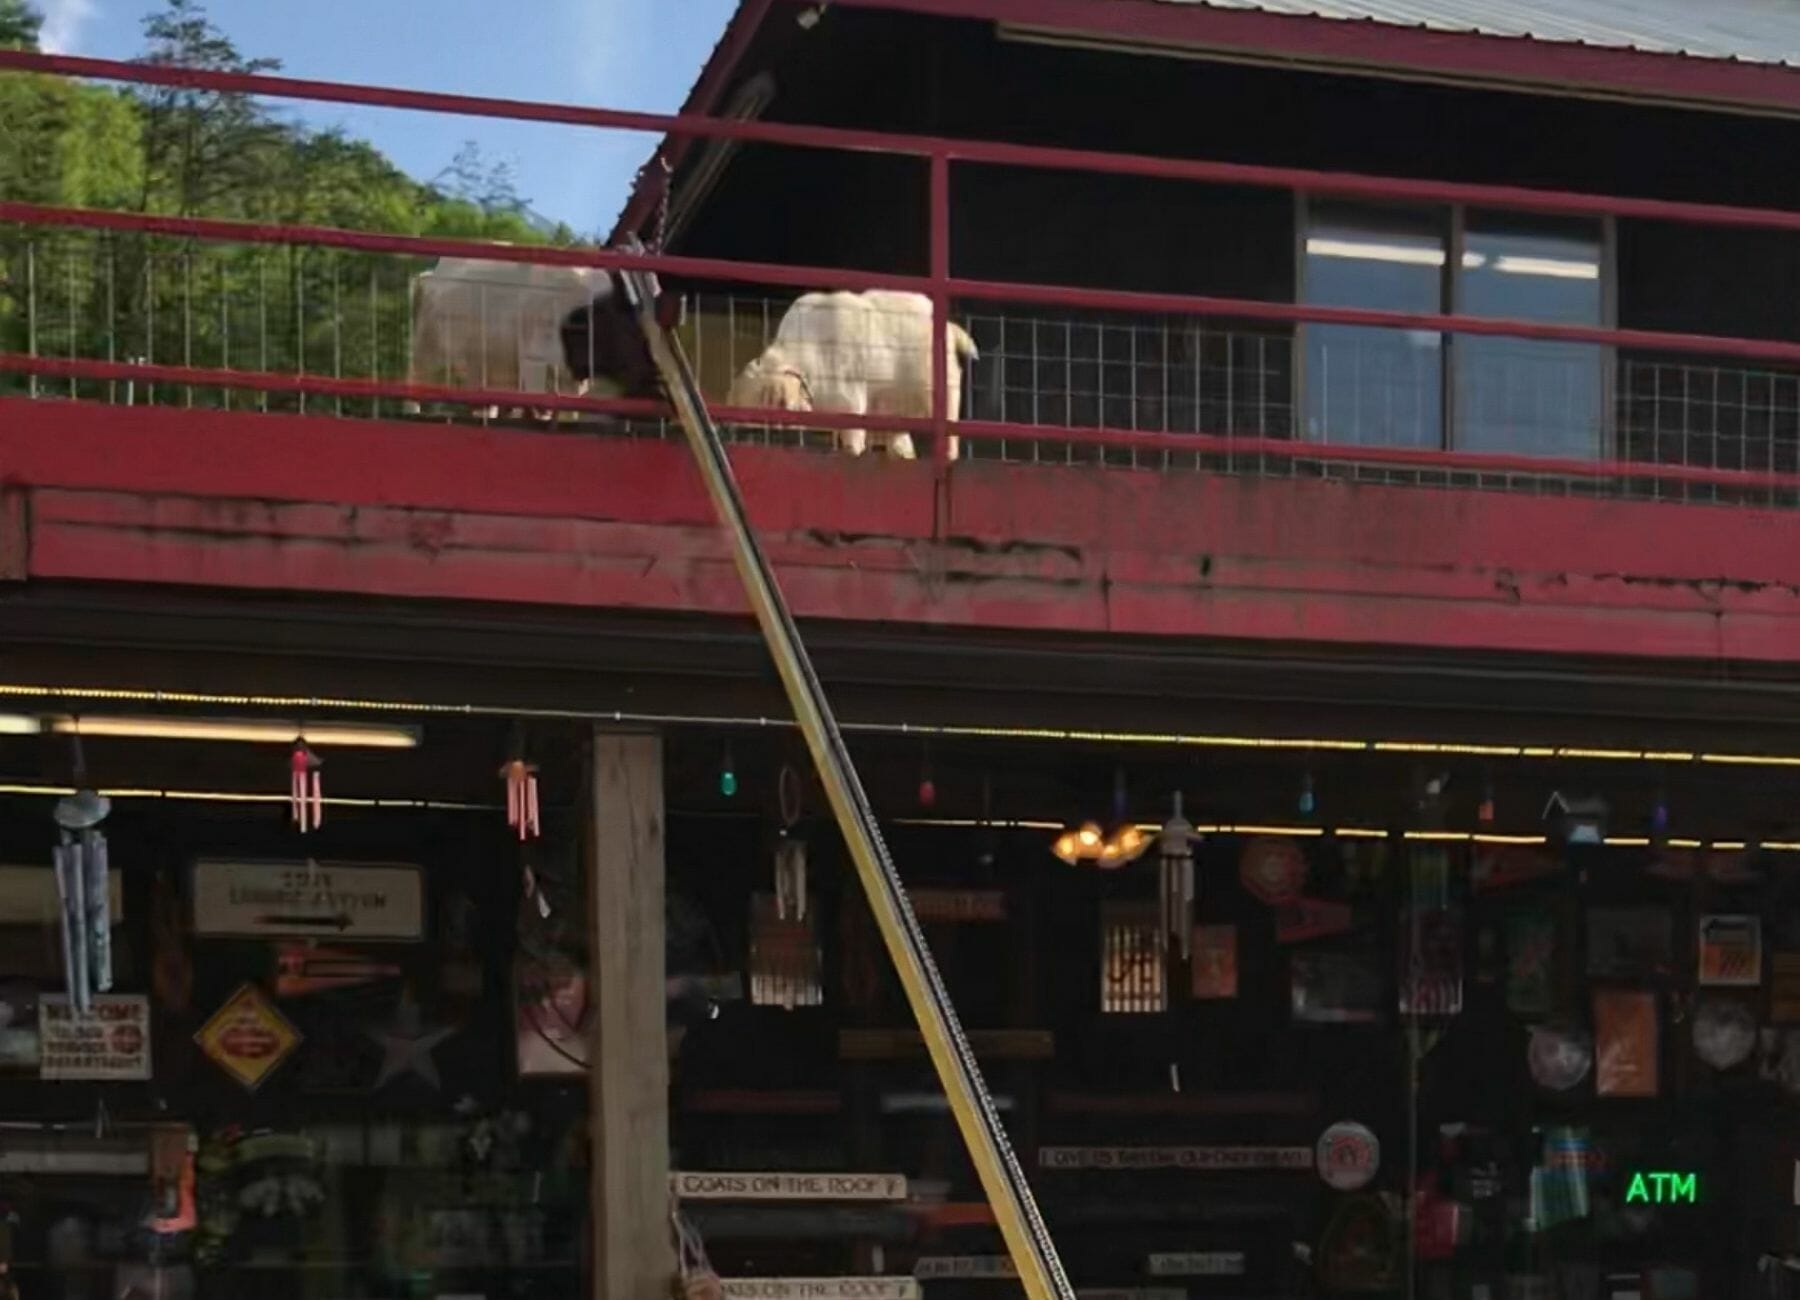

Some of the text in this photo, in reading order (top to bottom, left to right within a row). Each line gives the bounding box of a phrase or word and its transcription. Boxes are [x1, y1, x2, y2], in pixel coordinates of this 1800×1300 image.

[752, 1177, 780, 1192] ON
[787, 1178, 821, 1193] THE
[829, 1178, 876, 1193] ROOF
[1626, 1172, 1696, 1204] ATM
